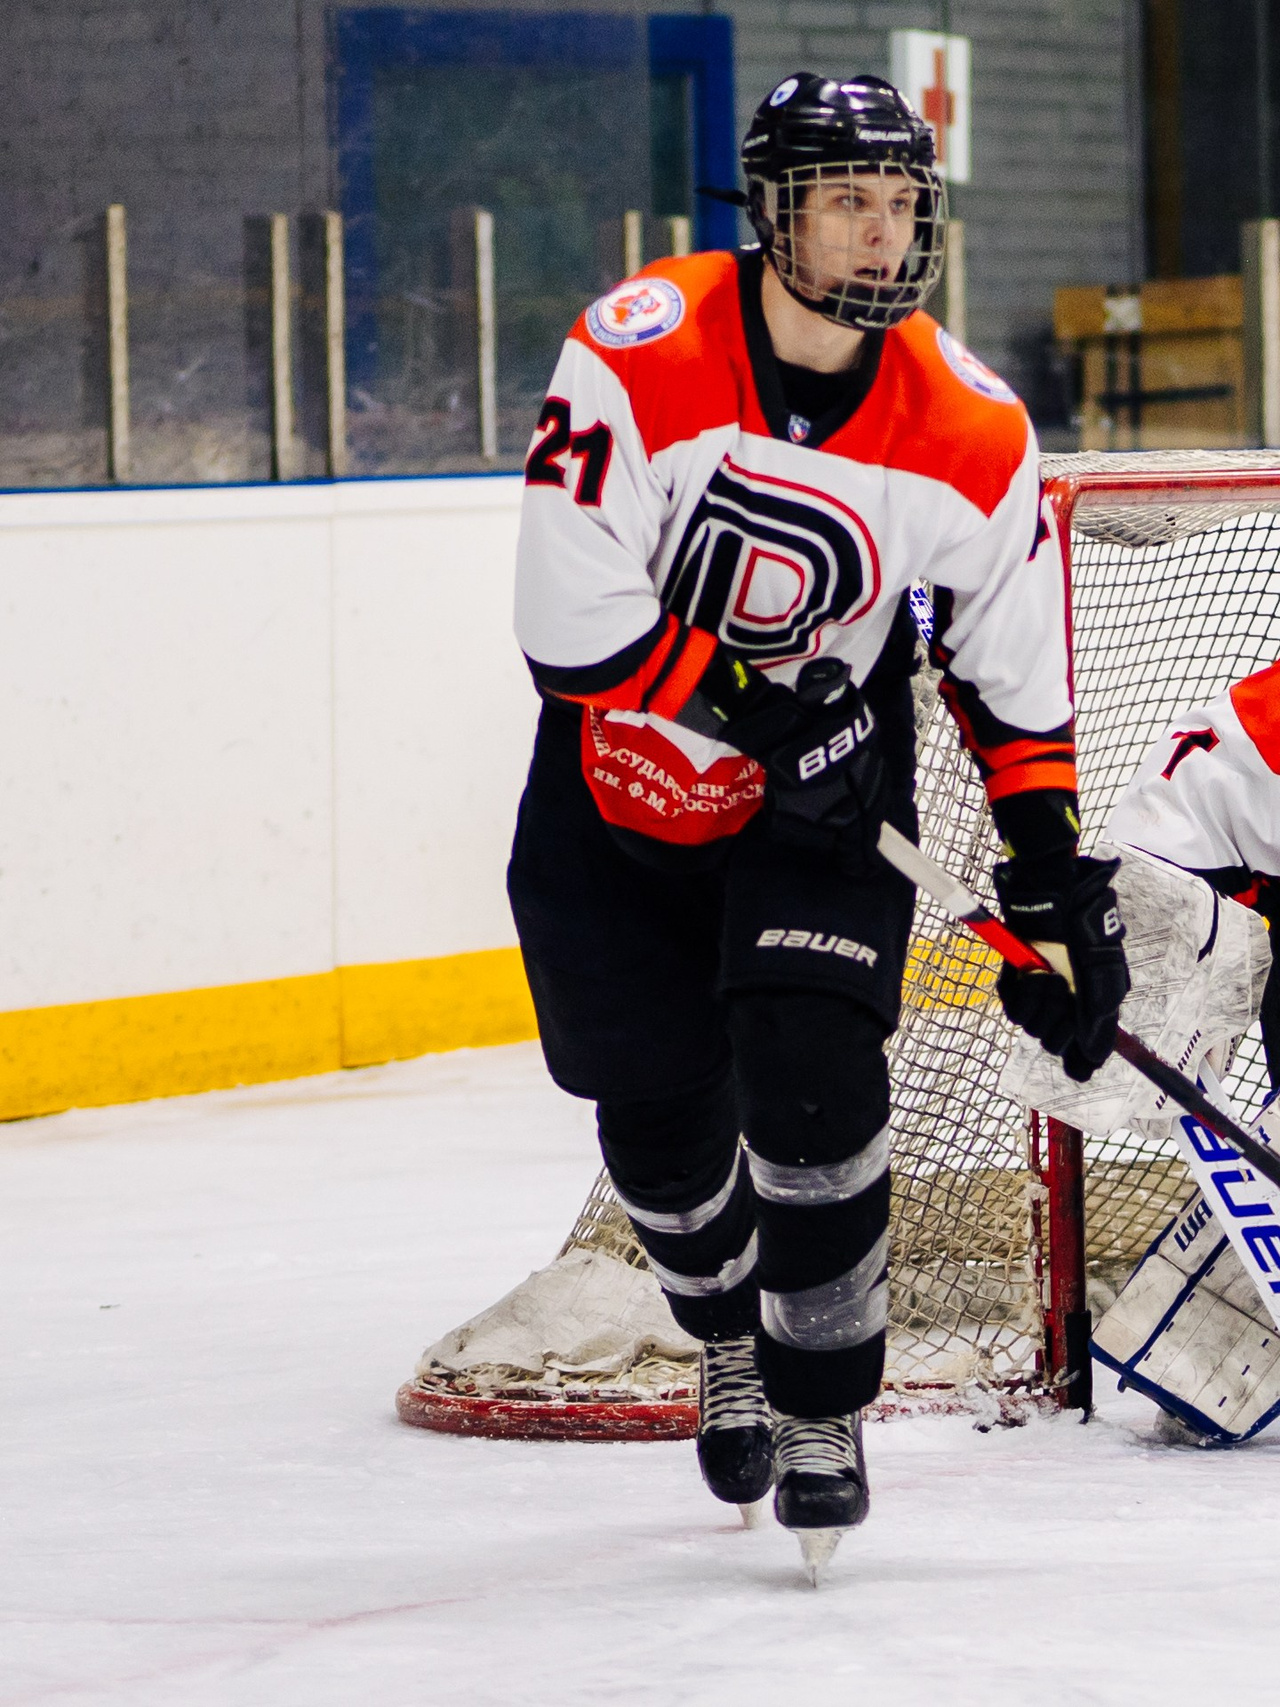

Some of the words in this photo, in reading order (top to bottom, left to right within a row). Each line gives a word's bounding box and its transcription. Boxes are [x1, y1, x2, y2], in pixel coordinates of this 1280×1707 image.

[525, 395, 614, 508] 21
[798, 702, 875, 781] BAU
[756, 929, 878, 969] BAUER
